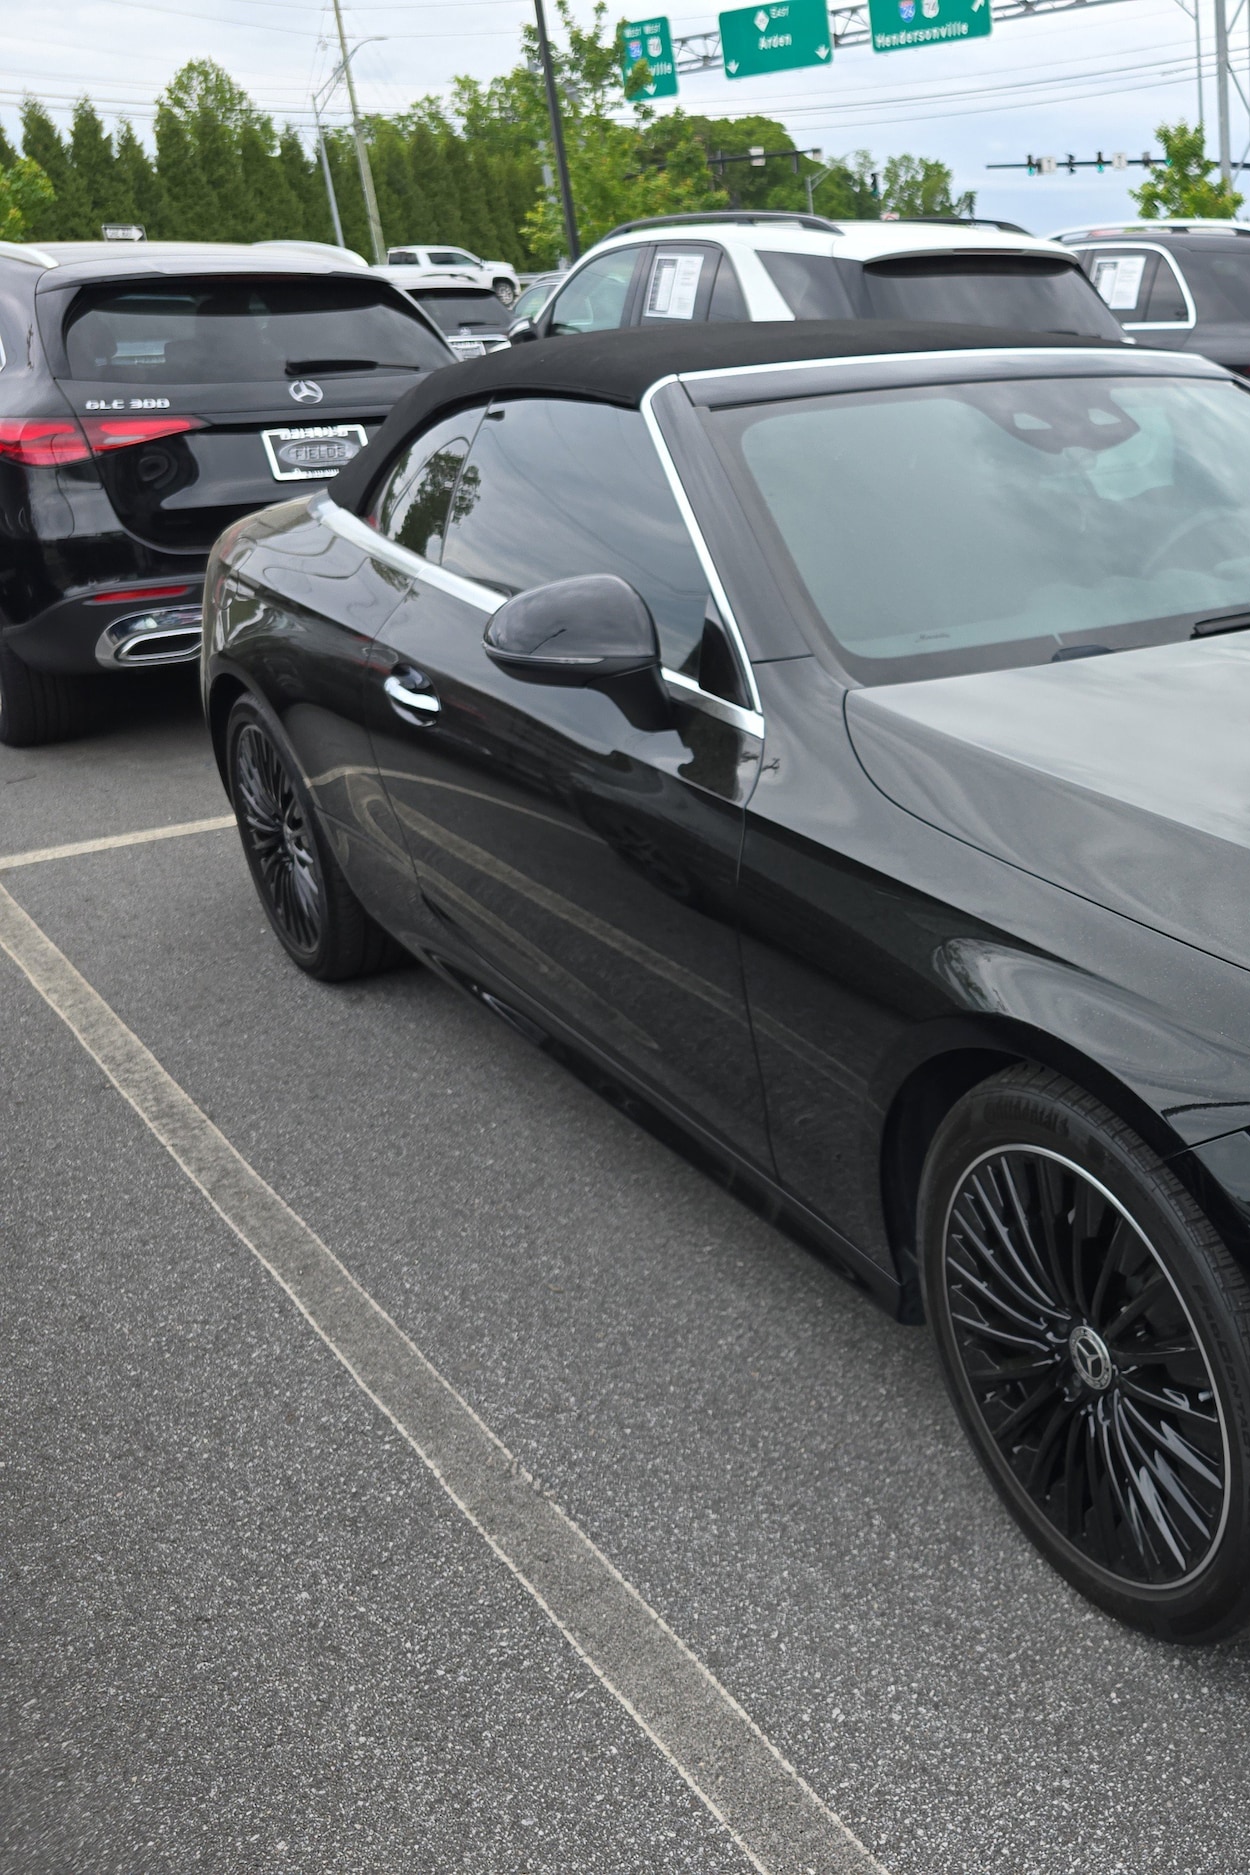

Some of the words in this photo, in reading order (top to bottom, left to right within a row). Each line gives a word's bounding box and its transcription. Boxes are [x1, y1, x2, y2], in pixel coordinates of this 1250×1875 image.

[758, 33, 792, 50] Arden
[875, 21, 969, 48] Hendersonville
[85, 399, 125, 410] GLC
[129, 398, 170, 409] 300
[294, 445, 347, 461] FIELDS
